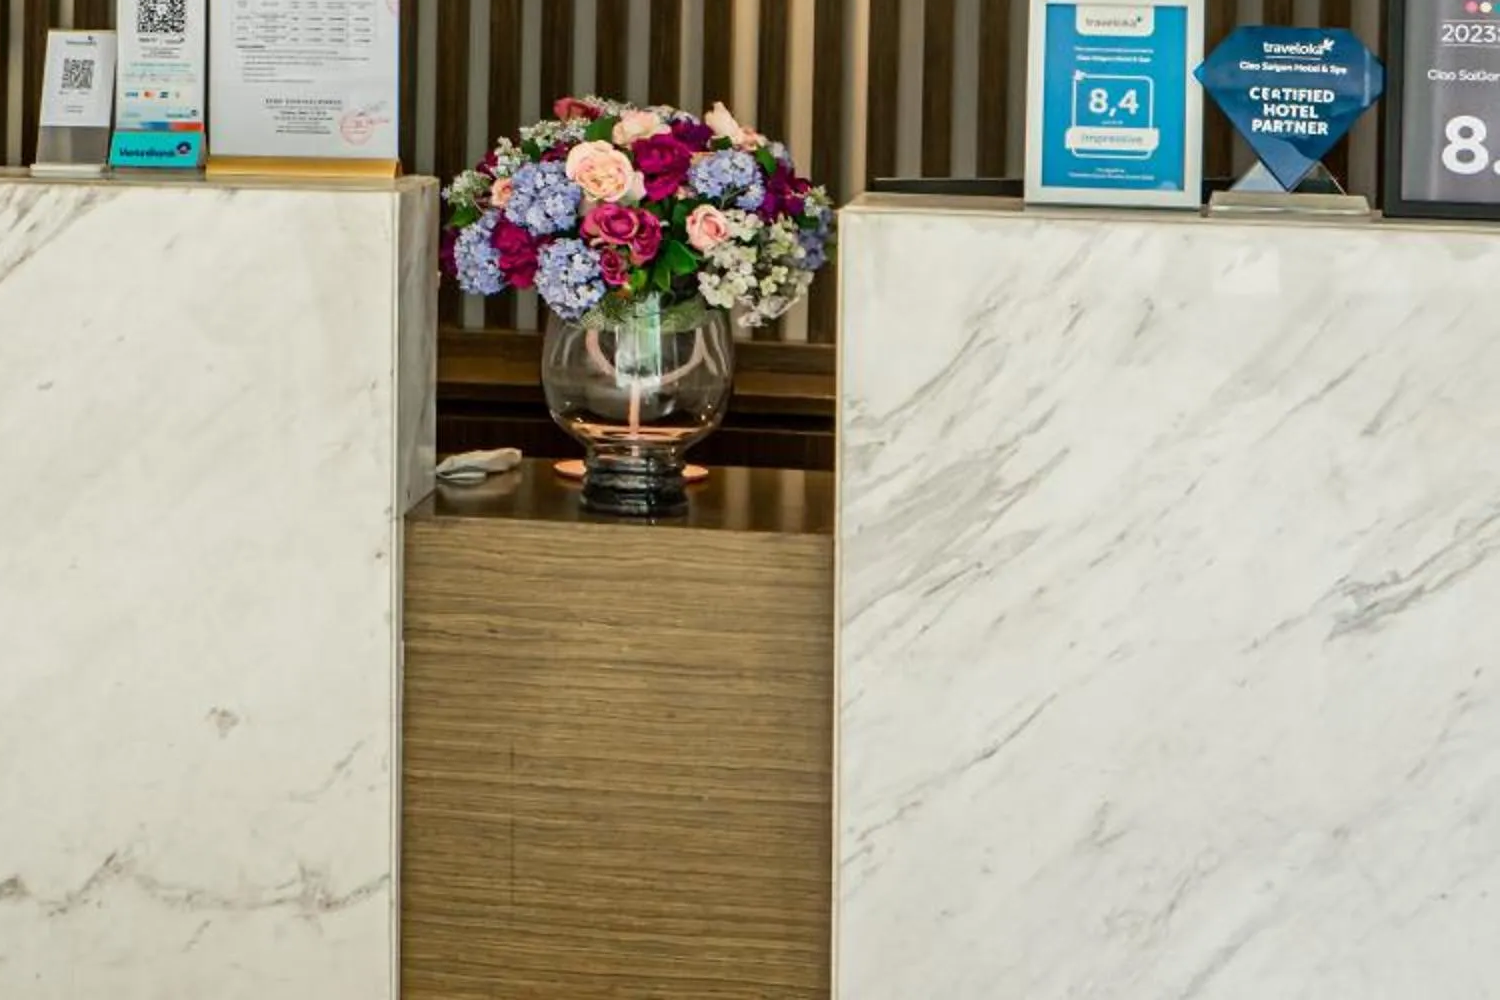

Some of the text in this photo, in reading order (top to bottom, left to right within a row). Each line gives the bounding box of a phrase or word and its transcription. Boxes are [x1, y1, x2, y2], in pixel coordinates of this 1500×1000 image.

[1441, 23, 1500, 44] 2023
[1263, 41, 1324, 55] traveloka
[1089, 88, 1140, 117] 8,4
[1249, 87, 1335, 103] CERTIFIED
[1263, 103, 1319, 119] HOTEL
[1251, 119, 1329, 135] PARTNER
